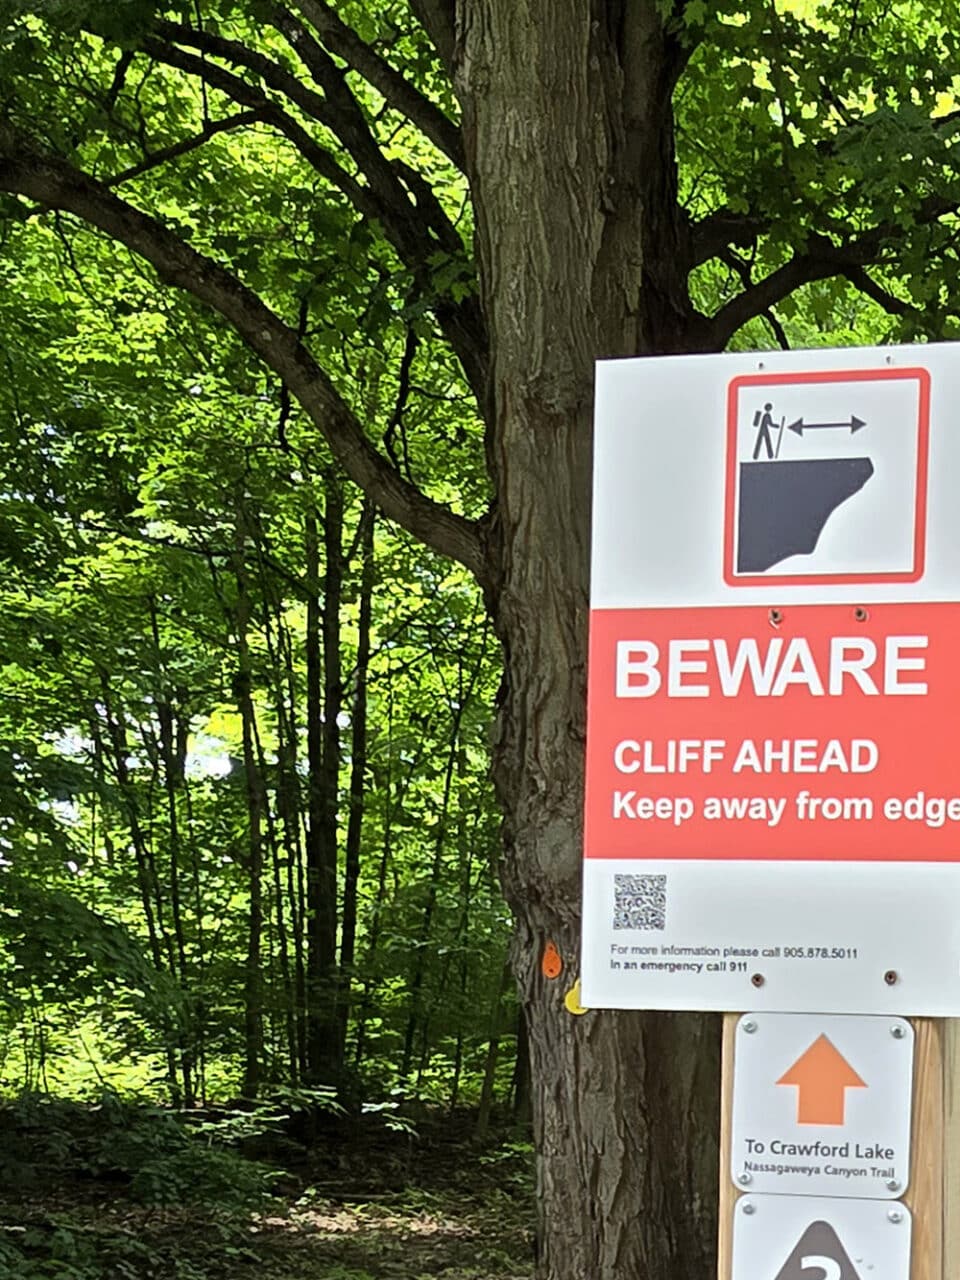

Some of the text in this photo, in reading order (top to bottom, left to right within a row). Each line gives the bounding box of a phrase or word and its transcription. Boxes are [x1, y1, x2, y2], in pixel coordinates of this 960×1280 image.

[615, 636, 929, 698] BEWARE
[613, 738, 879, 774] CLIFF AHEAD
[612, 790, 694, 826] Keep
[703, 797, 786, 827] away
[796, 790, 873, 820] from
[610, 944, 858, 959] For more information please call 905.878.5011
[610, 959, 748, 974] In an emergency call 911
[744, 1138, 895, 1160] To Crawford Lake
[744, 1160, 895, 1179] Nassagaweya Canyon Trail
